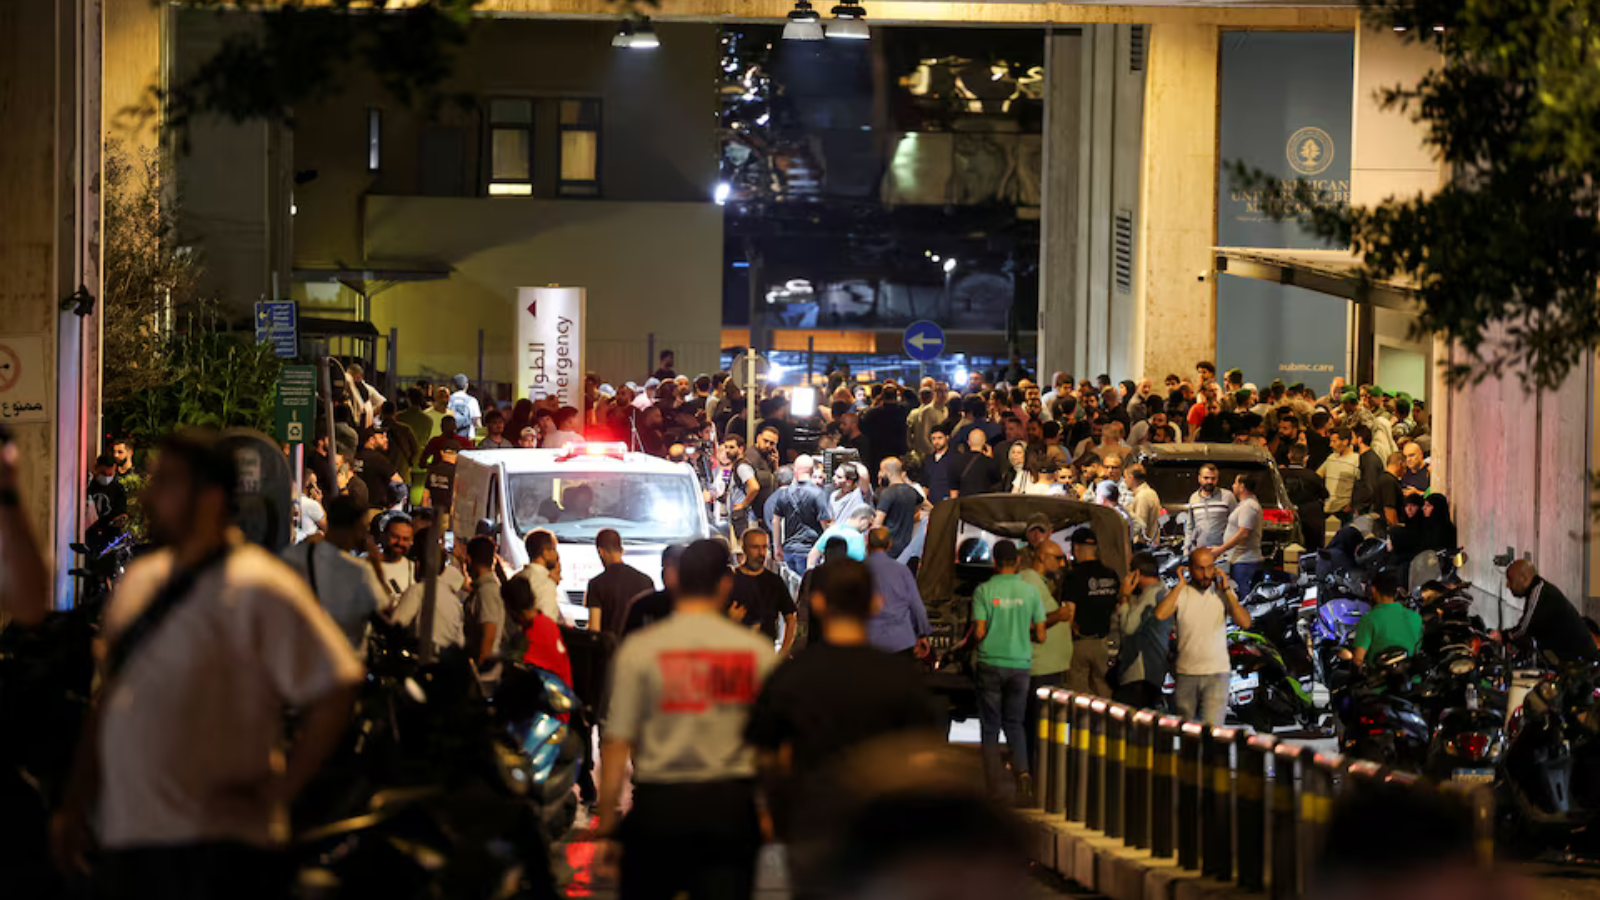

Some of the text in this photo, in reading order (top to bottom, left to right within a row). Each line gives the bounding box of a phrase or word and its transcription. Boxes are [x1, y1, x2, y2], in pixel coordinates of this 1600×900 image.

[556, 315, 573, 405] mergency
[1279, 363, 1334, 371] aubmc.care
[2, 401, 43, 418] ممنوع
